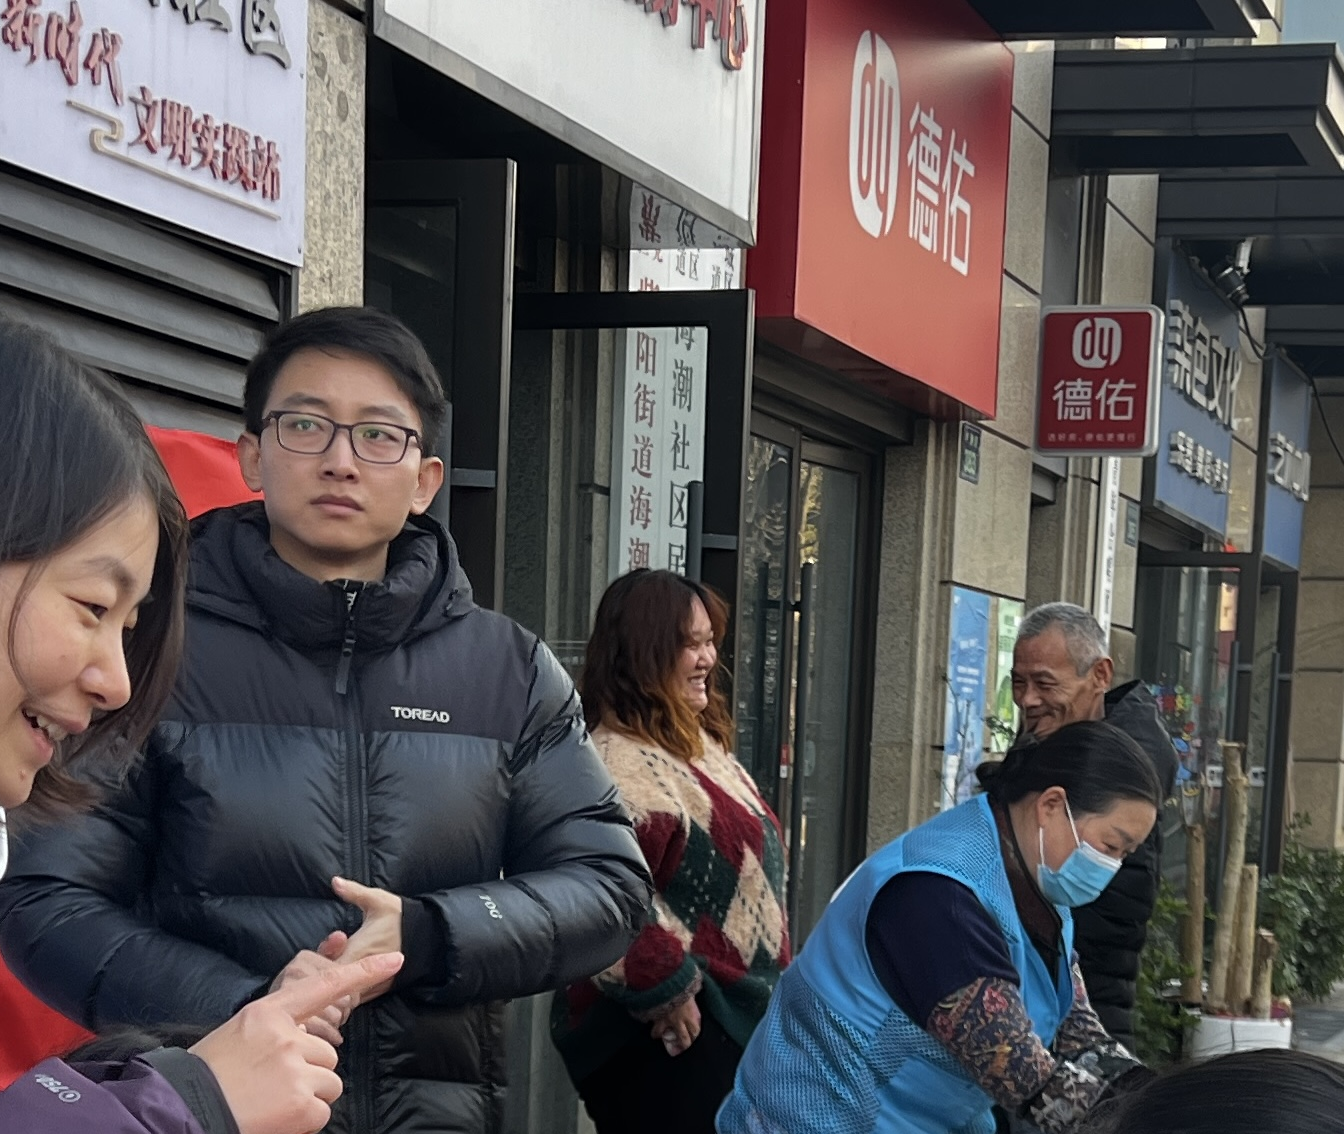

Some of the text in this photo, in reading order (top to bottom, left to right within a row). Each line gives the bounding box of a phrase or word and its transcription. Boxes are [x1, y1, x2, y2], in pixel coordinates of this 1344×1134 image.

[128, 86, 281, 201] 文明实践站
[907, 100, 975, 277] 德佑
[1052, 378, 1136, 420] 德佑
[390, 705, 450, 724] TOREAD
